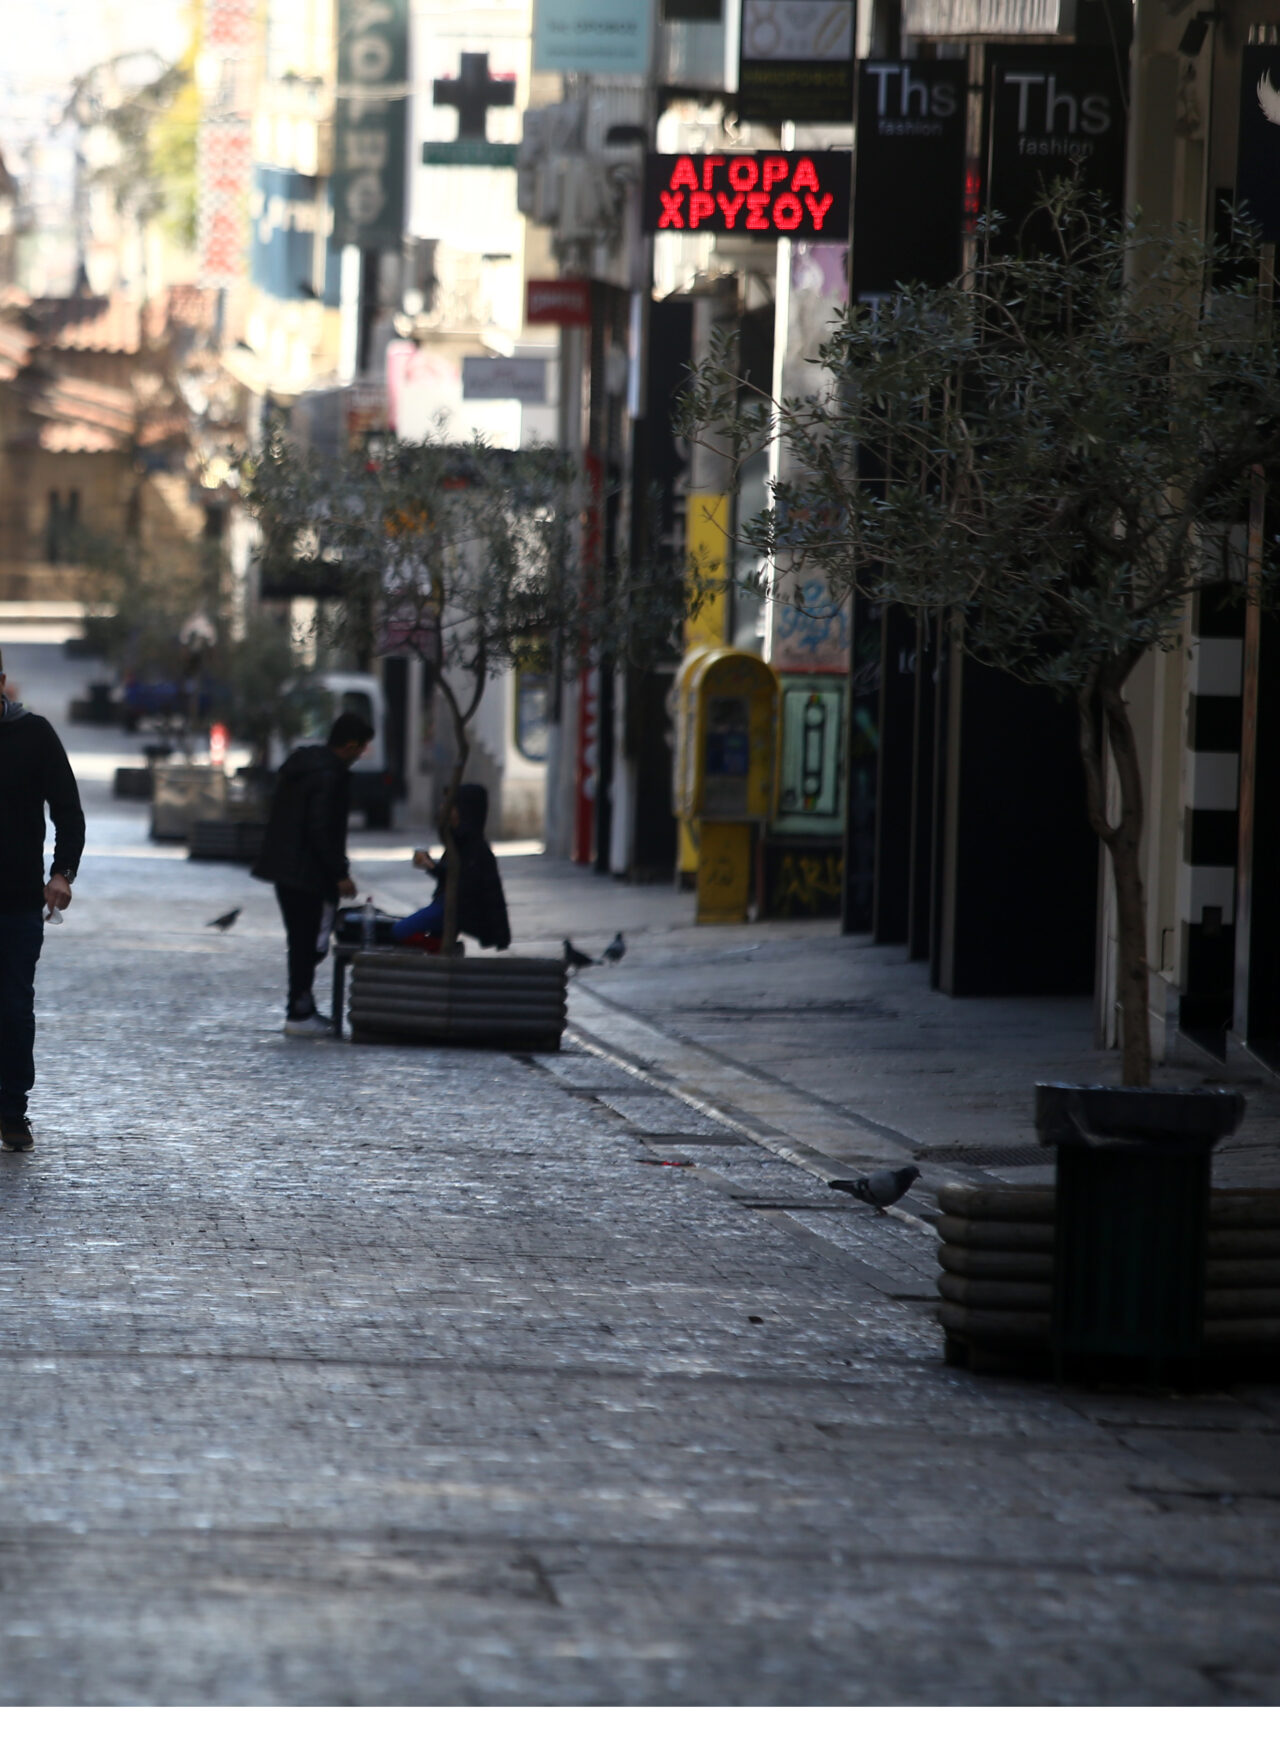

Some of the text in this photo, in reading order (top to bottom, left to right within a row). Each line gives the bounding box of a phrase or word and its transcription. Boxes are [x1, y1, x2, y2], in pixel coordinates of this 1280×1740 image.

[866, 63, 957, 117] Ths
[1004, 73, 1111, 134] Ths
[878, 119, 943, 136] fashion
[1019, 137, 1094, 156] fashion
[670, 155, 819, 193] ΑΓΟΡΑ
[658, 190, 833, 231] ΧΡΥΣΟΥ
